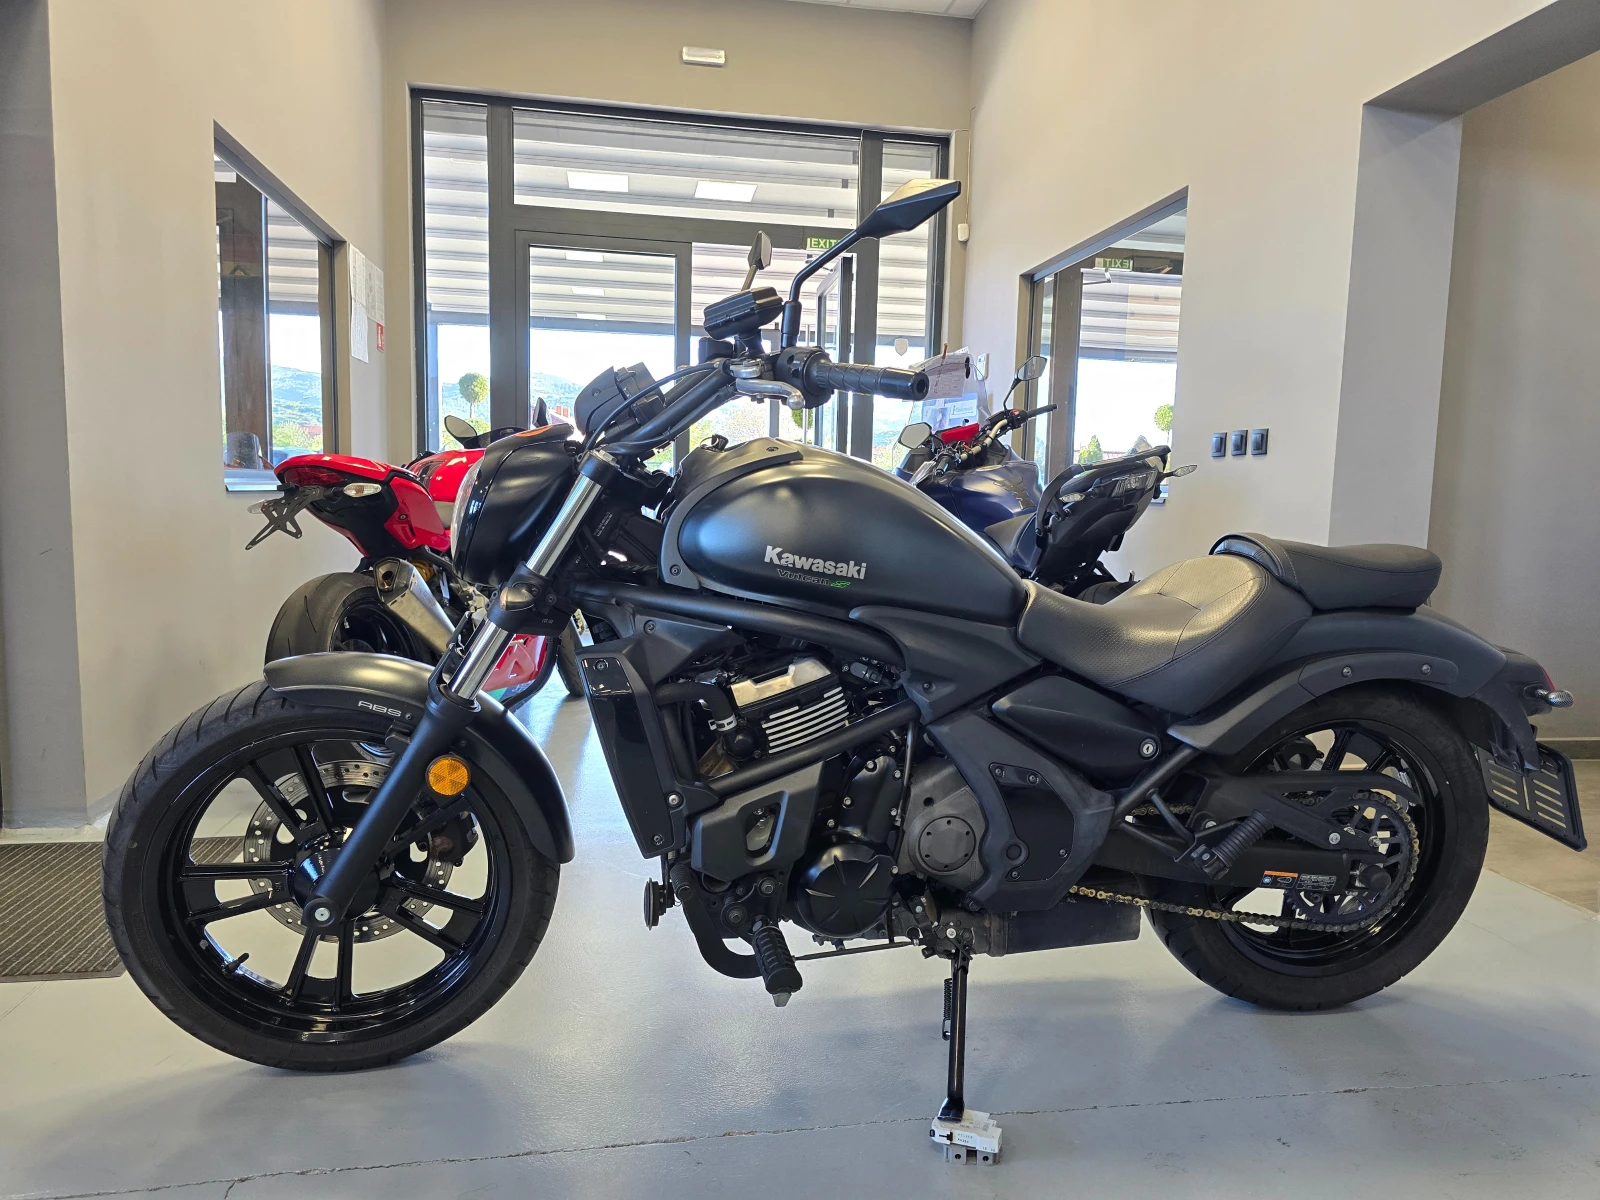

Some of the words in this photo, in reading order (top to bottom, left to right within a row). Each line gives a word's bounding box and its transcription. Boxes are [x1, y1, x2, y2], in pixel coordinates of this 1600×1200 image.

[811, 238, 837, 249] EXIT
[764, 545, 867, 580] Kawasaki
[776, 568, 830, 586] Vulcan
[358, 700, 402, 717] ABS
